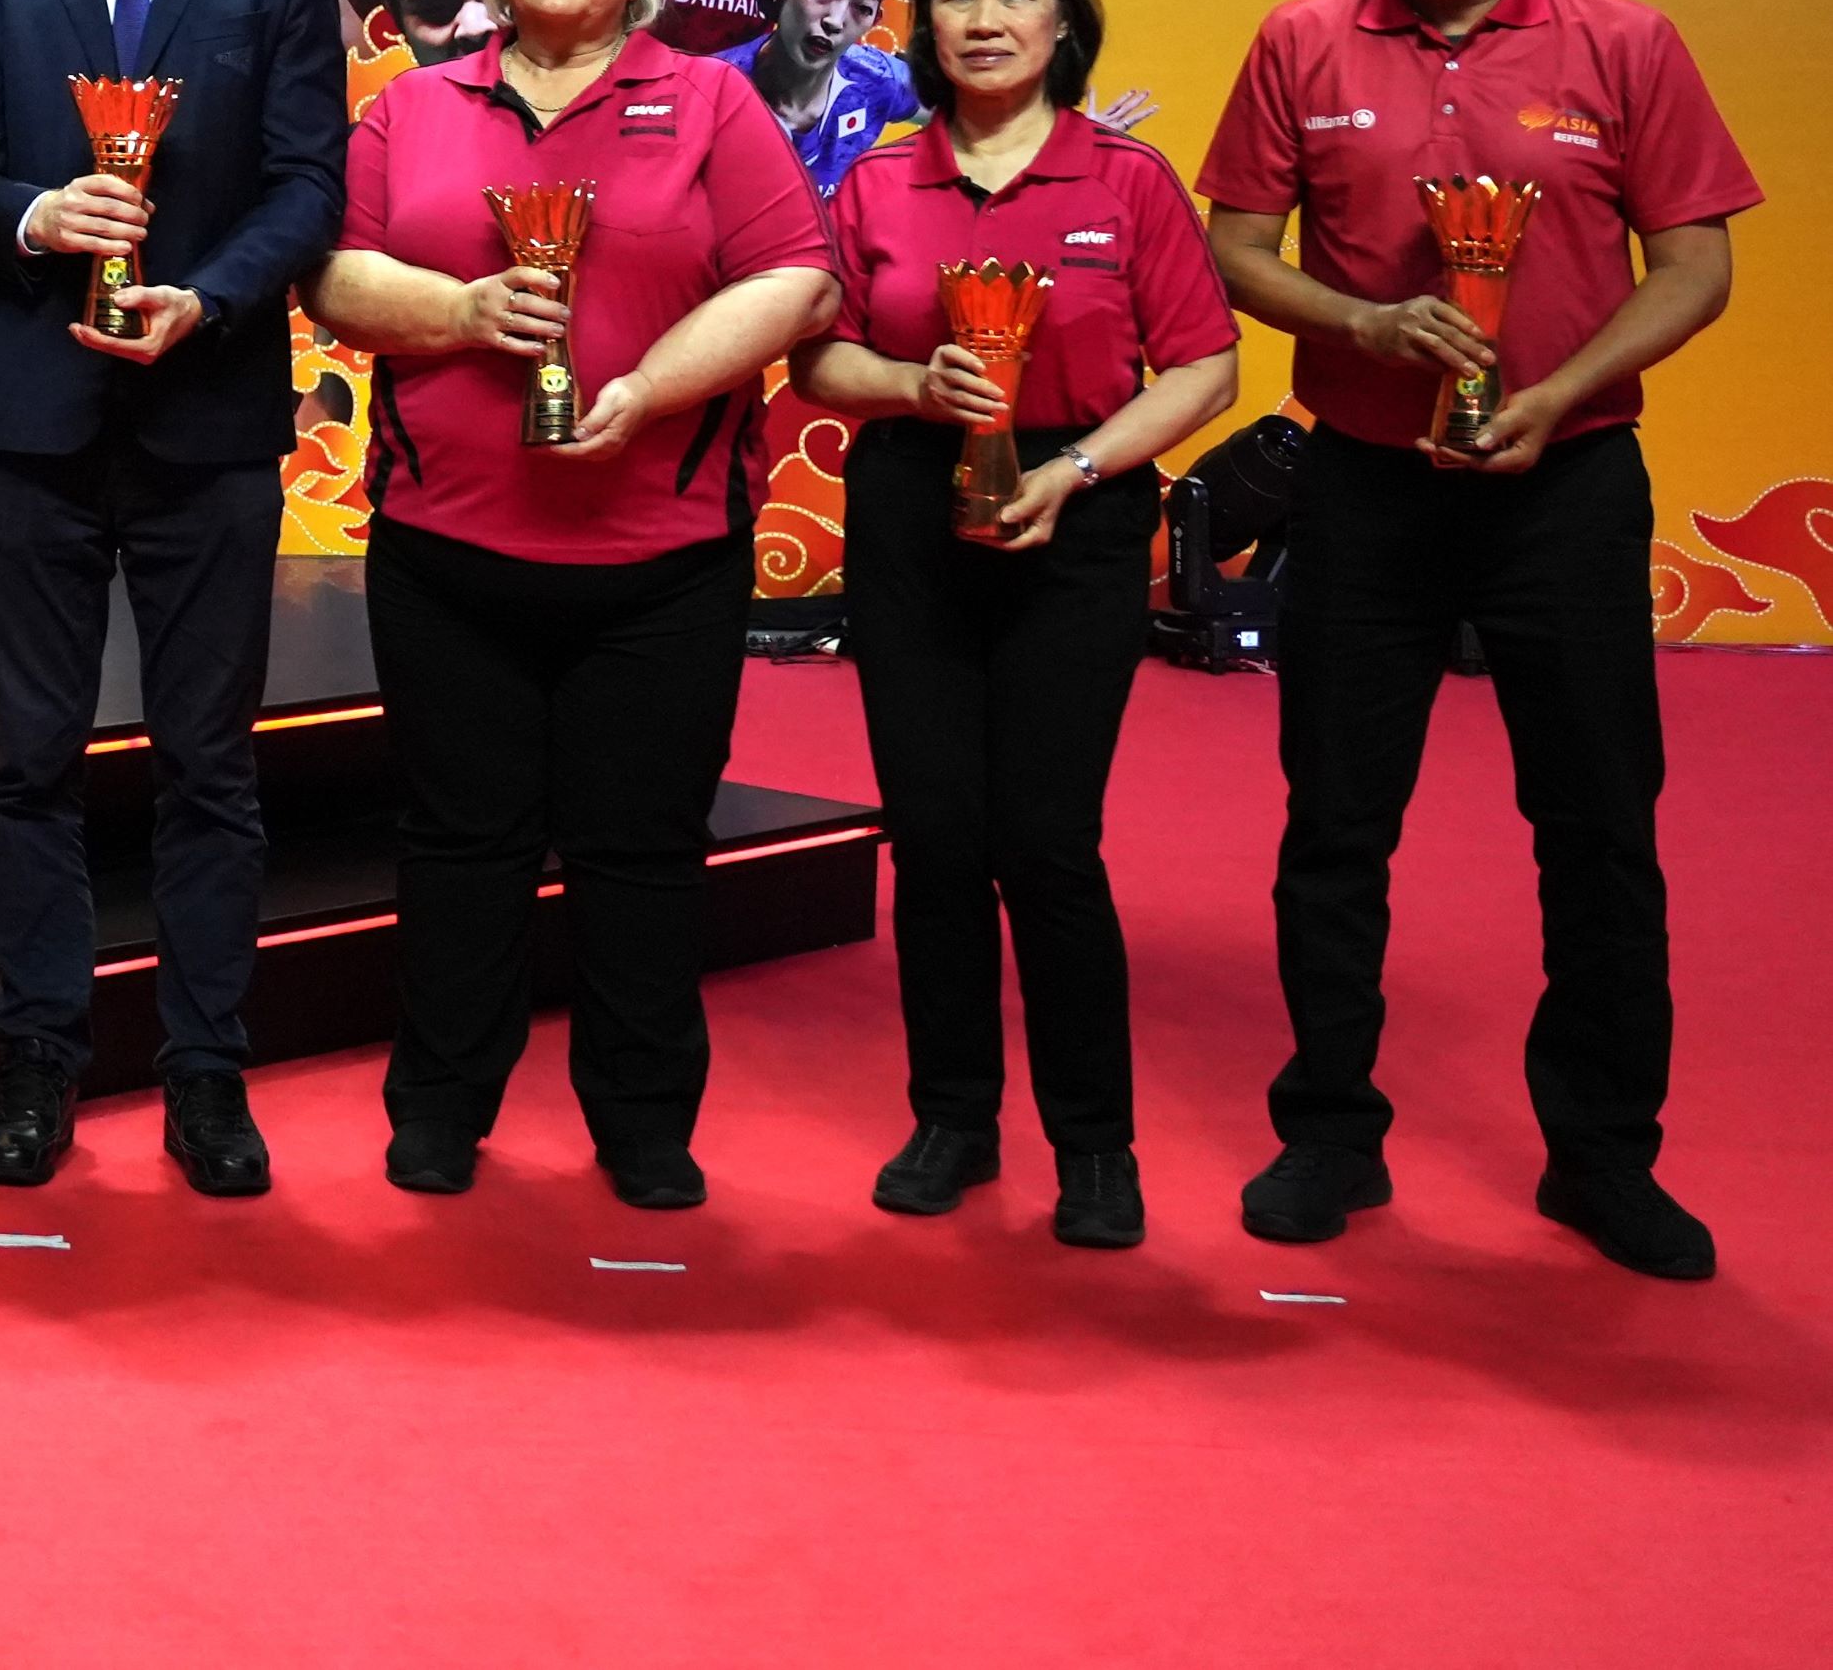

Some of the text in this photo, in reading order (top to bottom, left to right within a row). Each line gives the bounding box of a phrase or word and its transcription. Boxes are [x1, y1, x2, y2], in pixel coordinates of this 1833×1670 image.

[624, 104, 674, 117] BWF
[1555, 115, 1599, 136] ASIA
[1064, 230, 1116, 244] BWF
